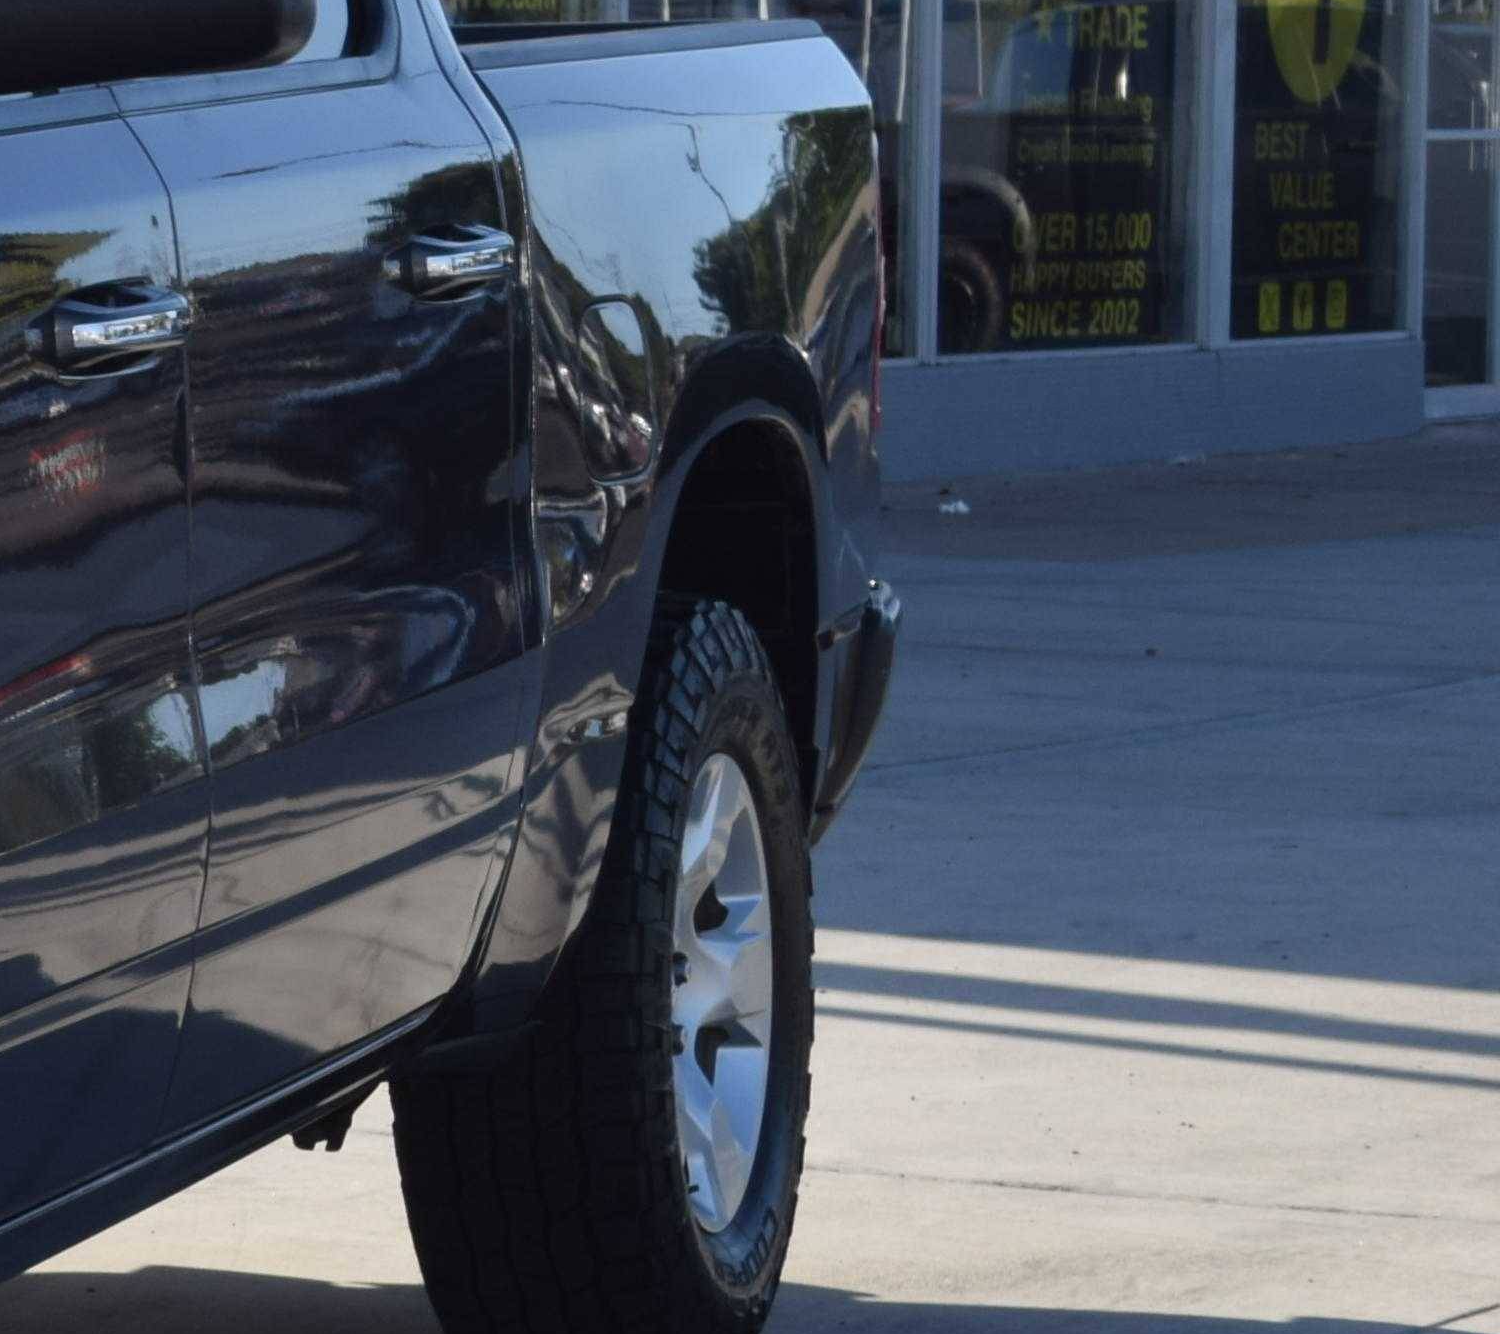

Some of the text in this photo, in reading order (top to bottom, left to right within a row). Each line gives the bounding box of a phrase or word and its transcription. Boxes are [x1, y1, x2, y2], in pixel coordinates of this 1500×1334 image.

[1062, 2, 1148, 50] TRADE
[1254, 121, 1310, 162] BEST
[1269, 170, 1335, 210] VALUE
[1012, 211, 1076, 252] OVER
[1277, 219, 1360, 260] CENTER
[1011, 259, 1148, 294] HAPPY BUYERS
[1010, 298, 1141, 340] SINCE 2002
